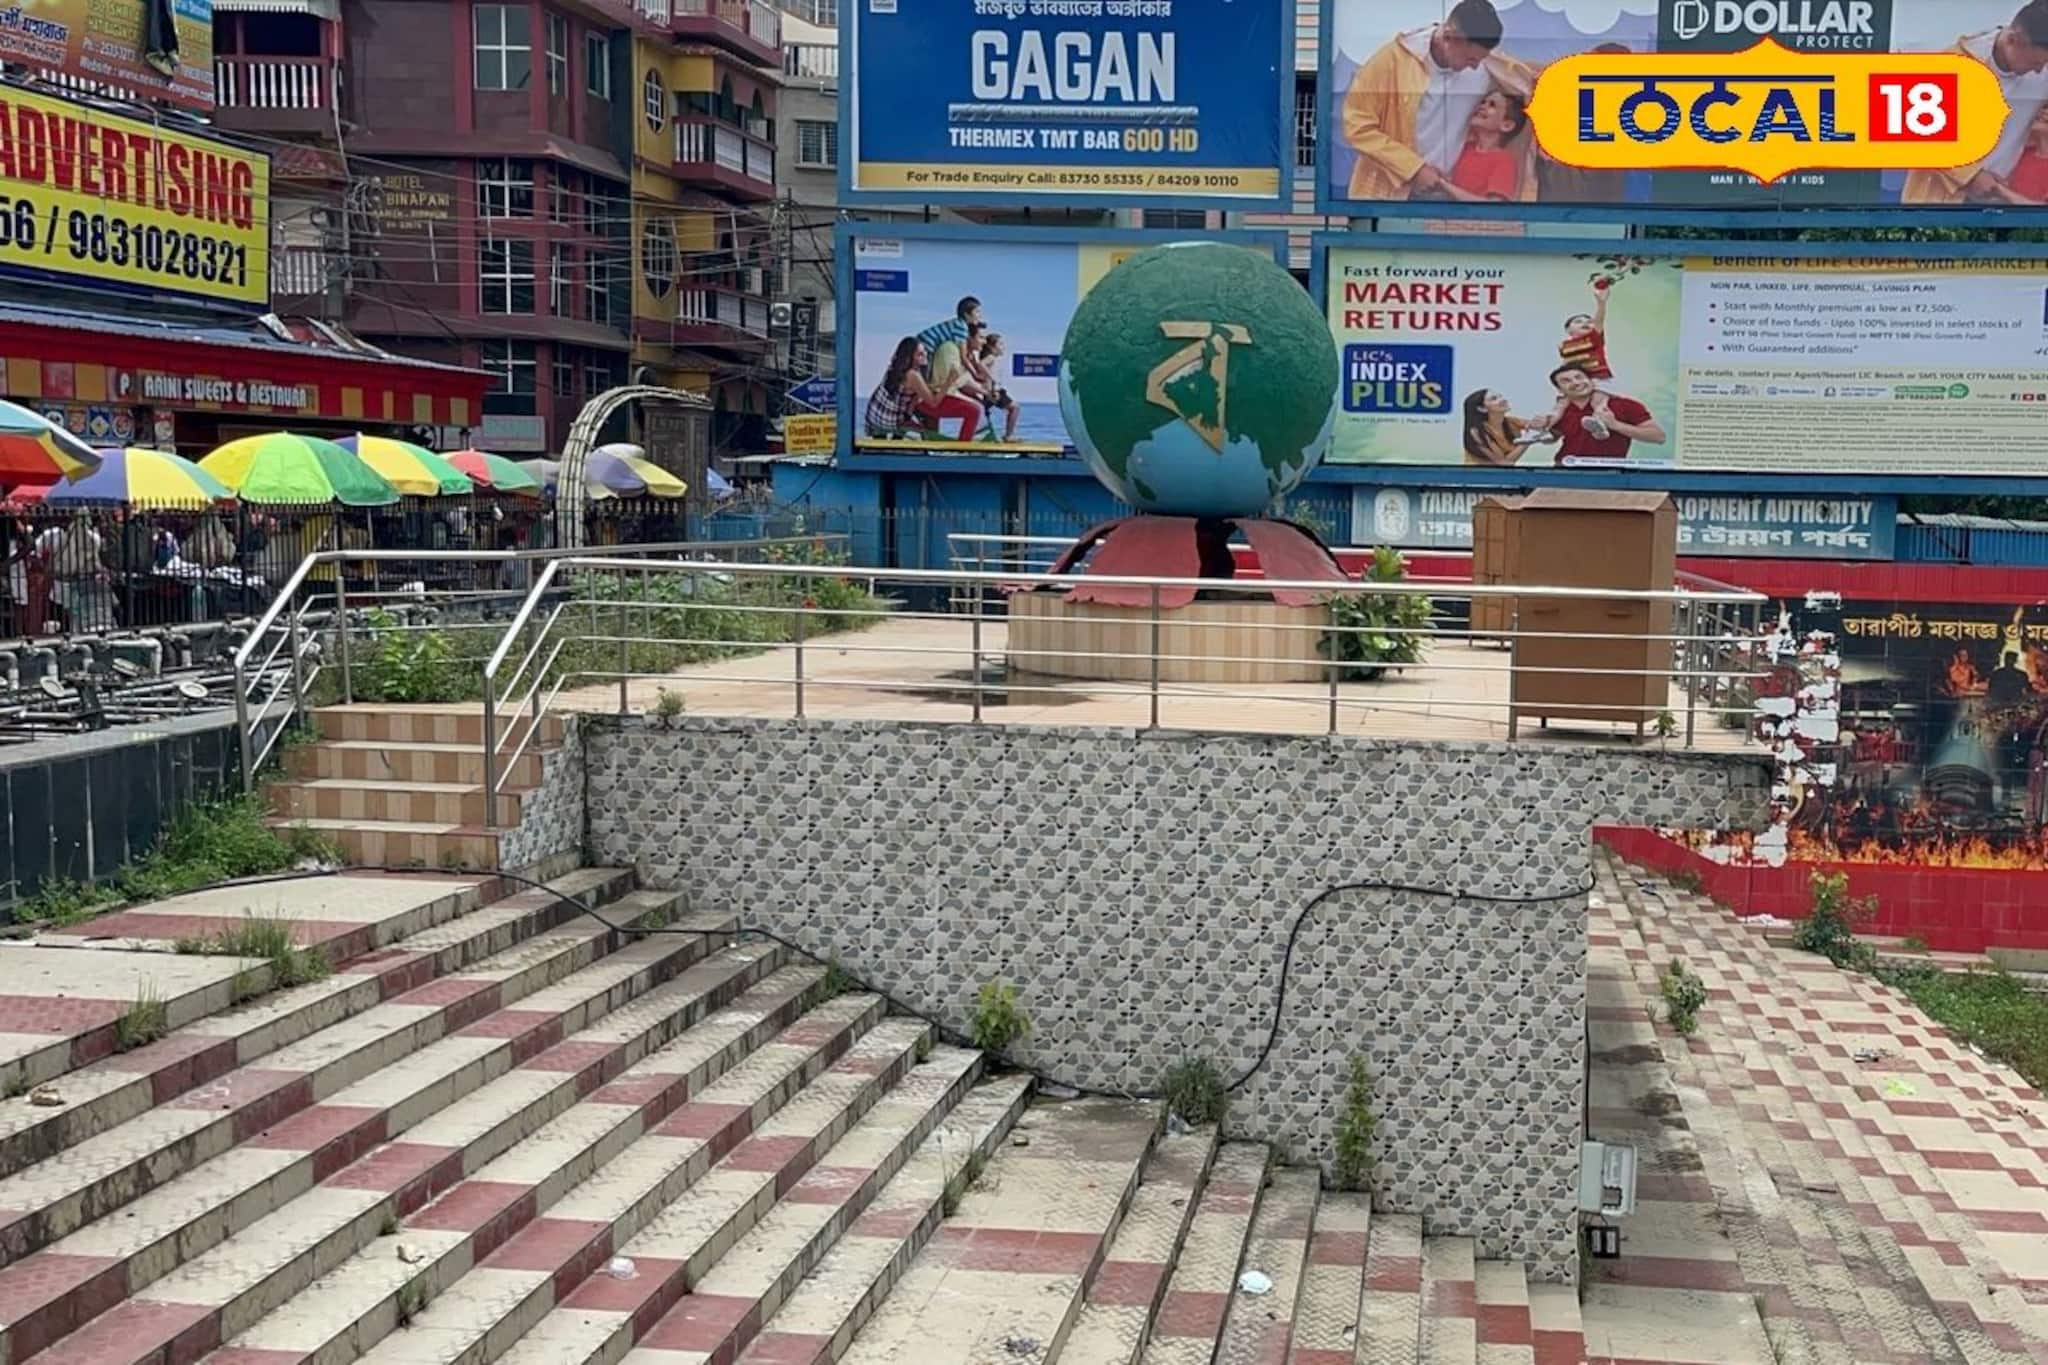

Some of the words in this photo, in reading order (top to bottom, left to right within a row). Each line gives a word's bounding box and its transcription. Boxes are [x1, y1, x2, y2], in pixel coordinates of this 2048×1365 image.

[1714, 1, 1874, 34] DOLLAR
[1796, 35, 1874, 48] PROTECT
[971, 30, 1175, 102] GAGAN
[949, 128, 1034, 148] THERMEX
[1040, 129, 1078, 149] TMT
[1083, 130, 1119, 150] BAR
[1123, 128, 1164, 152] 600
[1169, 129, 1199, 152] HD
[0, 103, 254, 230] ADVERTISING
[907, 170, 930, 182] For
[933, 171, 969, 182] Trade
[973, 172, 1024, 186] Enquiry
[1027, 173, 1056, 184] Call:
[1059, 173, 1100, 185] 83730
[1104, 174, 1144, 185] 55335
[1158, 174, 1200, 186] 84209
[1204, 175, 1240, 187] 10110
[1711, 175, 1733, 184] MAN
[1801, 175, 1825, 185] KIDS
[68, 209, 247, 287] 9831028321
[1344, 266, 1379, 277] Fast
[1386, 265, 1458, 278] forward
[1465, 269, 1504, 280] your
[1345, 282, 1505, 304] MARKET
[1723, 303, 1747, 311] Start
[1751, 303, 1771, 311] with
[1774, 303, 1815, 313] Monthly
[1818, 304, 1862, 314] premium
[1879, 304, 1898, 312] low
[1344, 310, 1503, 331] RETURNS
[1722, 316, 1755, 326] Choice
[1758, 316, 1769, 326] of
[1771, 318, 1791, 326] two
[1793, 317, 1821, 327] funds
[1831, 318, 1855, 329] Upto
[1890, 319, 1931, 328] invested
[1947, 319, 1975, 328] select
[1978, 320, 2008, 328] stocks
[1352, 351, 1393, 361] LIC's
[1722, 344, 1744, 352] With
[1747, 344, 1805, 354] Guaranteed
[1351, 362, 1427, 381] INDEX
[185, 378, 233, 403] SWEETS
[236, 381, 246, 403] &
[1352, 382, 1442, 408] PLUS
[1765, 500, 1873, 525] AUTHORITY
[1843, 613, 1923, 638] তারাপীঠ
[1928, 619, 1998, 640] মহাযজ্ঞ
